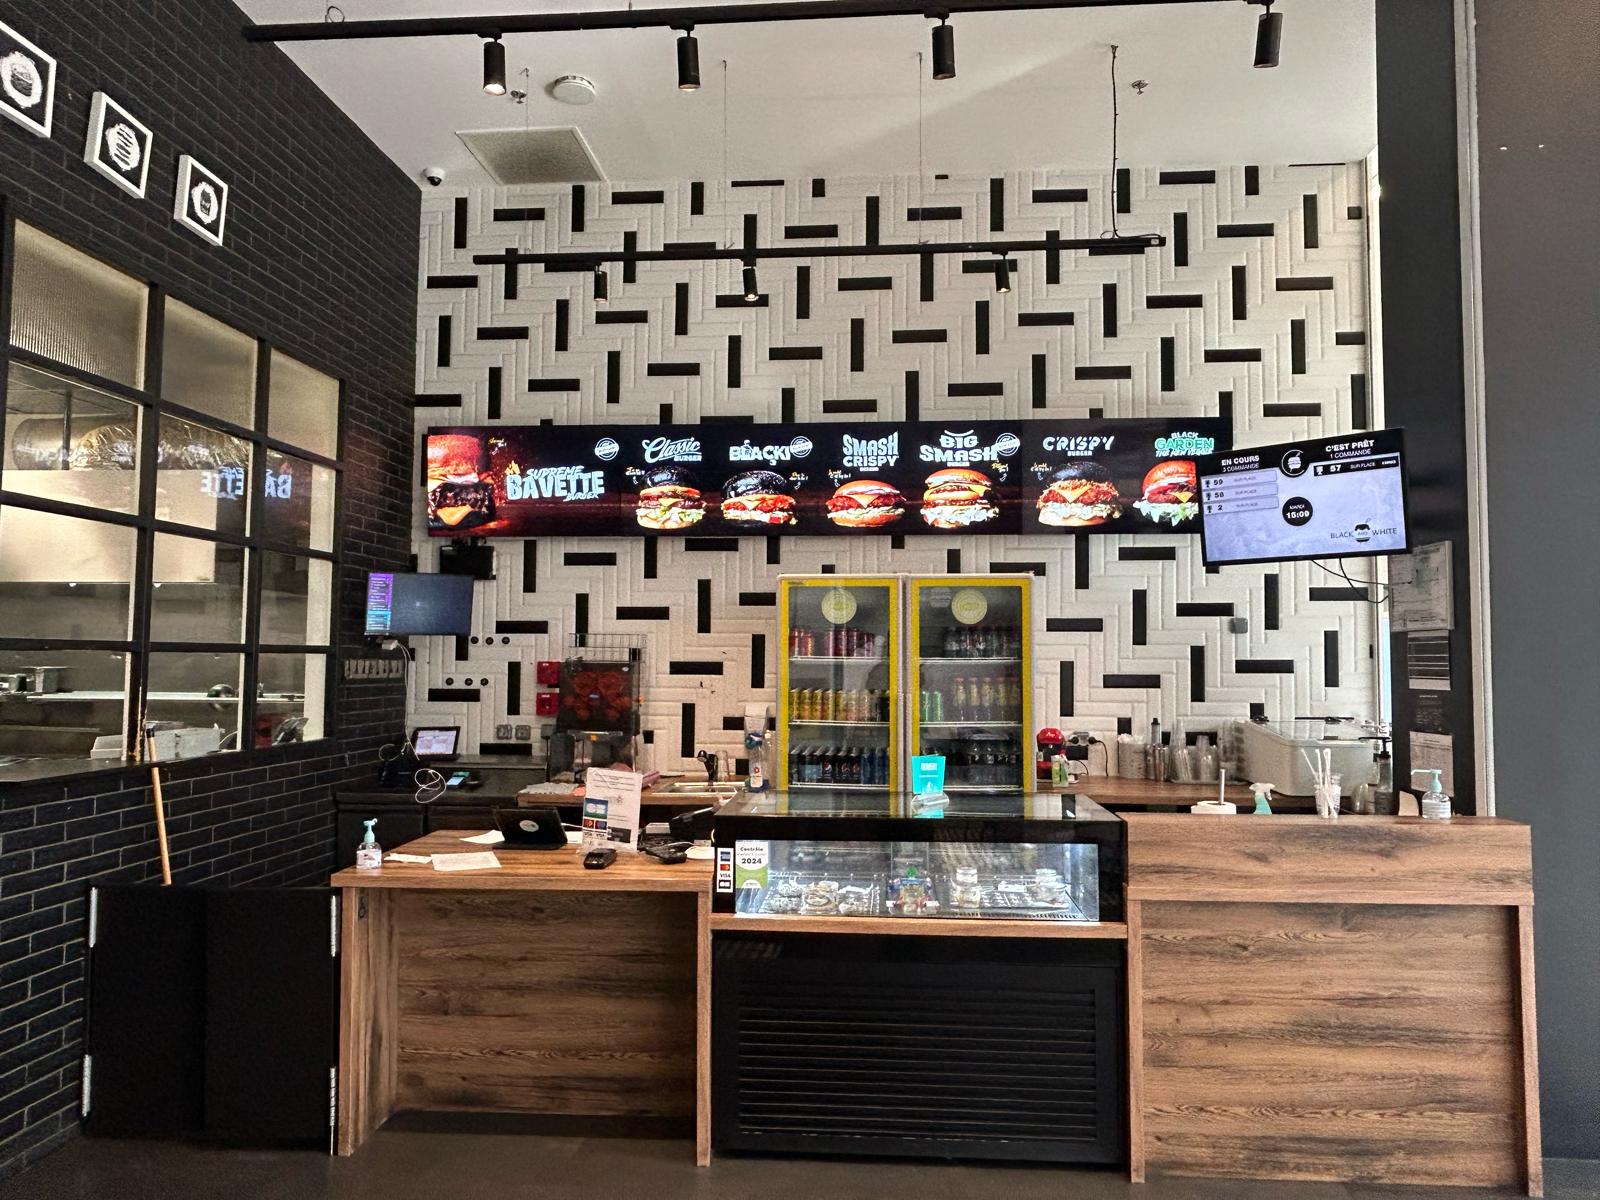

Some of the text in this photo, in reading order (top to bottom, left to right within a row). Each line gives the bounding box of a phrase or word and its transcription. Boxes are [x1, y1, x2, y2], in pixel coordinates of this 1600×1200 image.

[1171, 431, 1199, 439] BLACK
[842, 431, 899, 456] SMASH
[939, 435, 978, 448] BIG
[1042, 436, 1115, 451] CRISPY
[1154, 437, 1214, 451] GARDEN
[1325, 439, 1375, 452] C'EST PRÊT
[641, 436, 702, 464] Classic
[919, 444, 998, 462] SMASH
[1334, 448, 1372, 459] COMMANDE
[673, 454, 702, 462] BURGER
[843, 455, 899, 467] CRISPY
[1233, 455, 1260, 464] COURS
[1226, 463, 1260, 472] COMMANDE
[1329, 464, 1342, 472] 57
[524, 465, 585, 483] SUPREME
[506, 470, 605, 500] BAVETTE
[1213, 478, 1223, 486] 59
[1330, 530, 1354, 539] BLACK
[1371, 528, 1398, 536] WHITE
